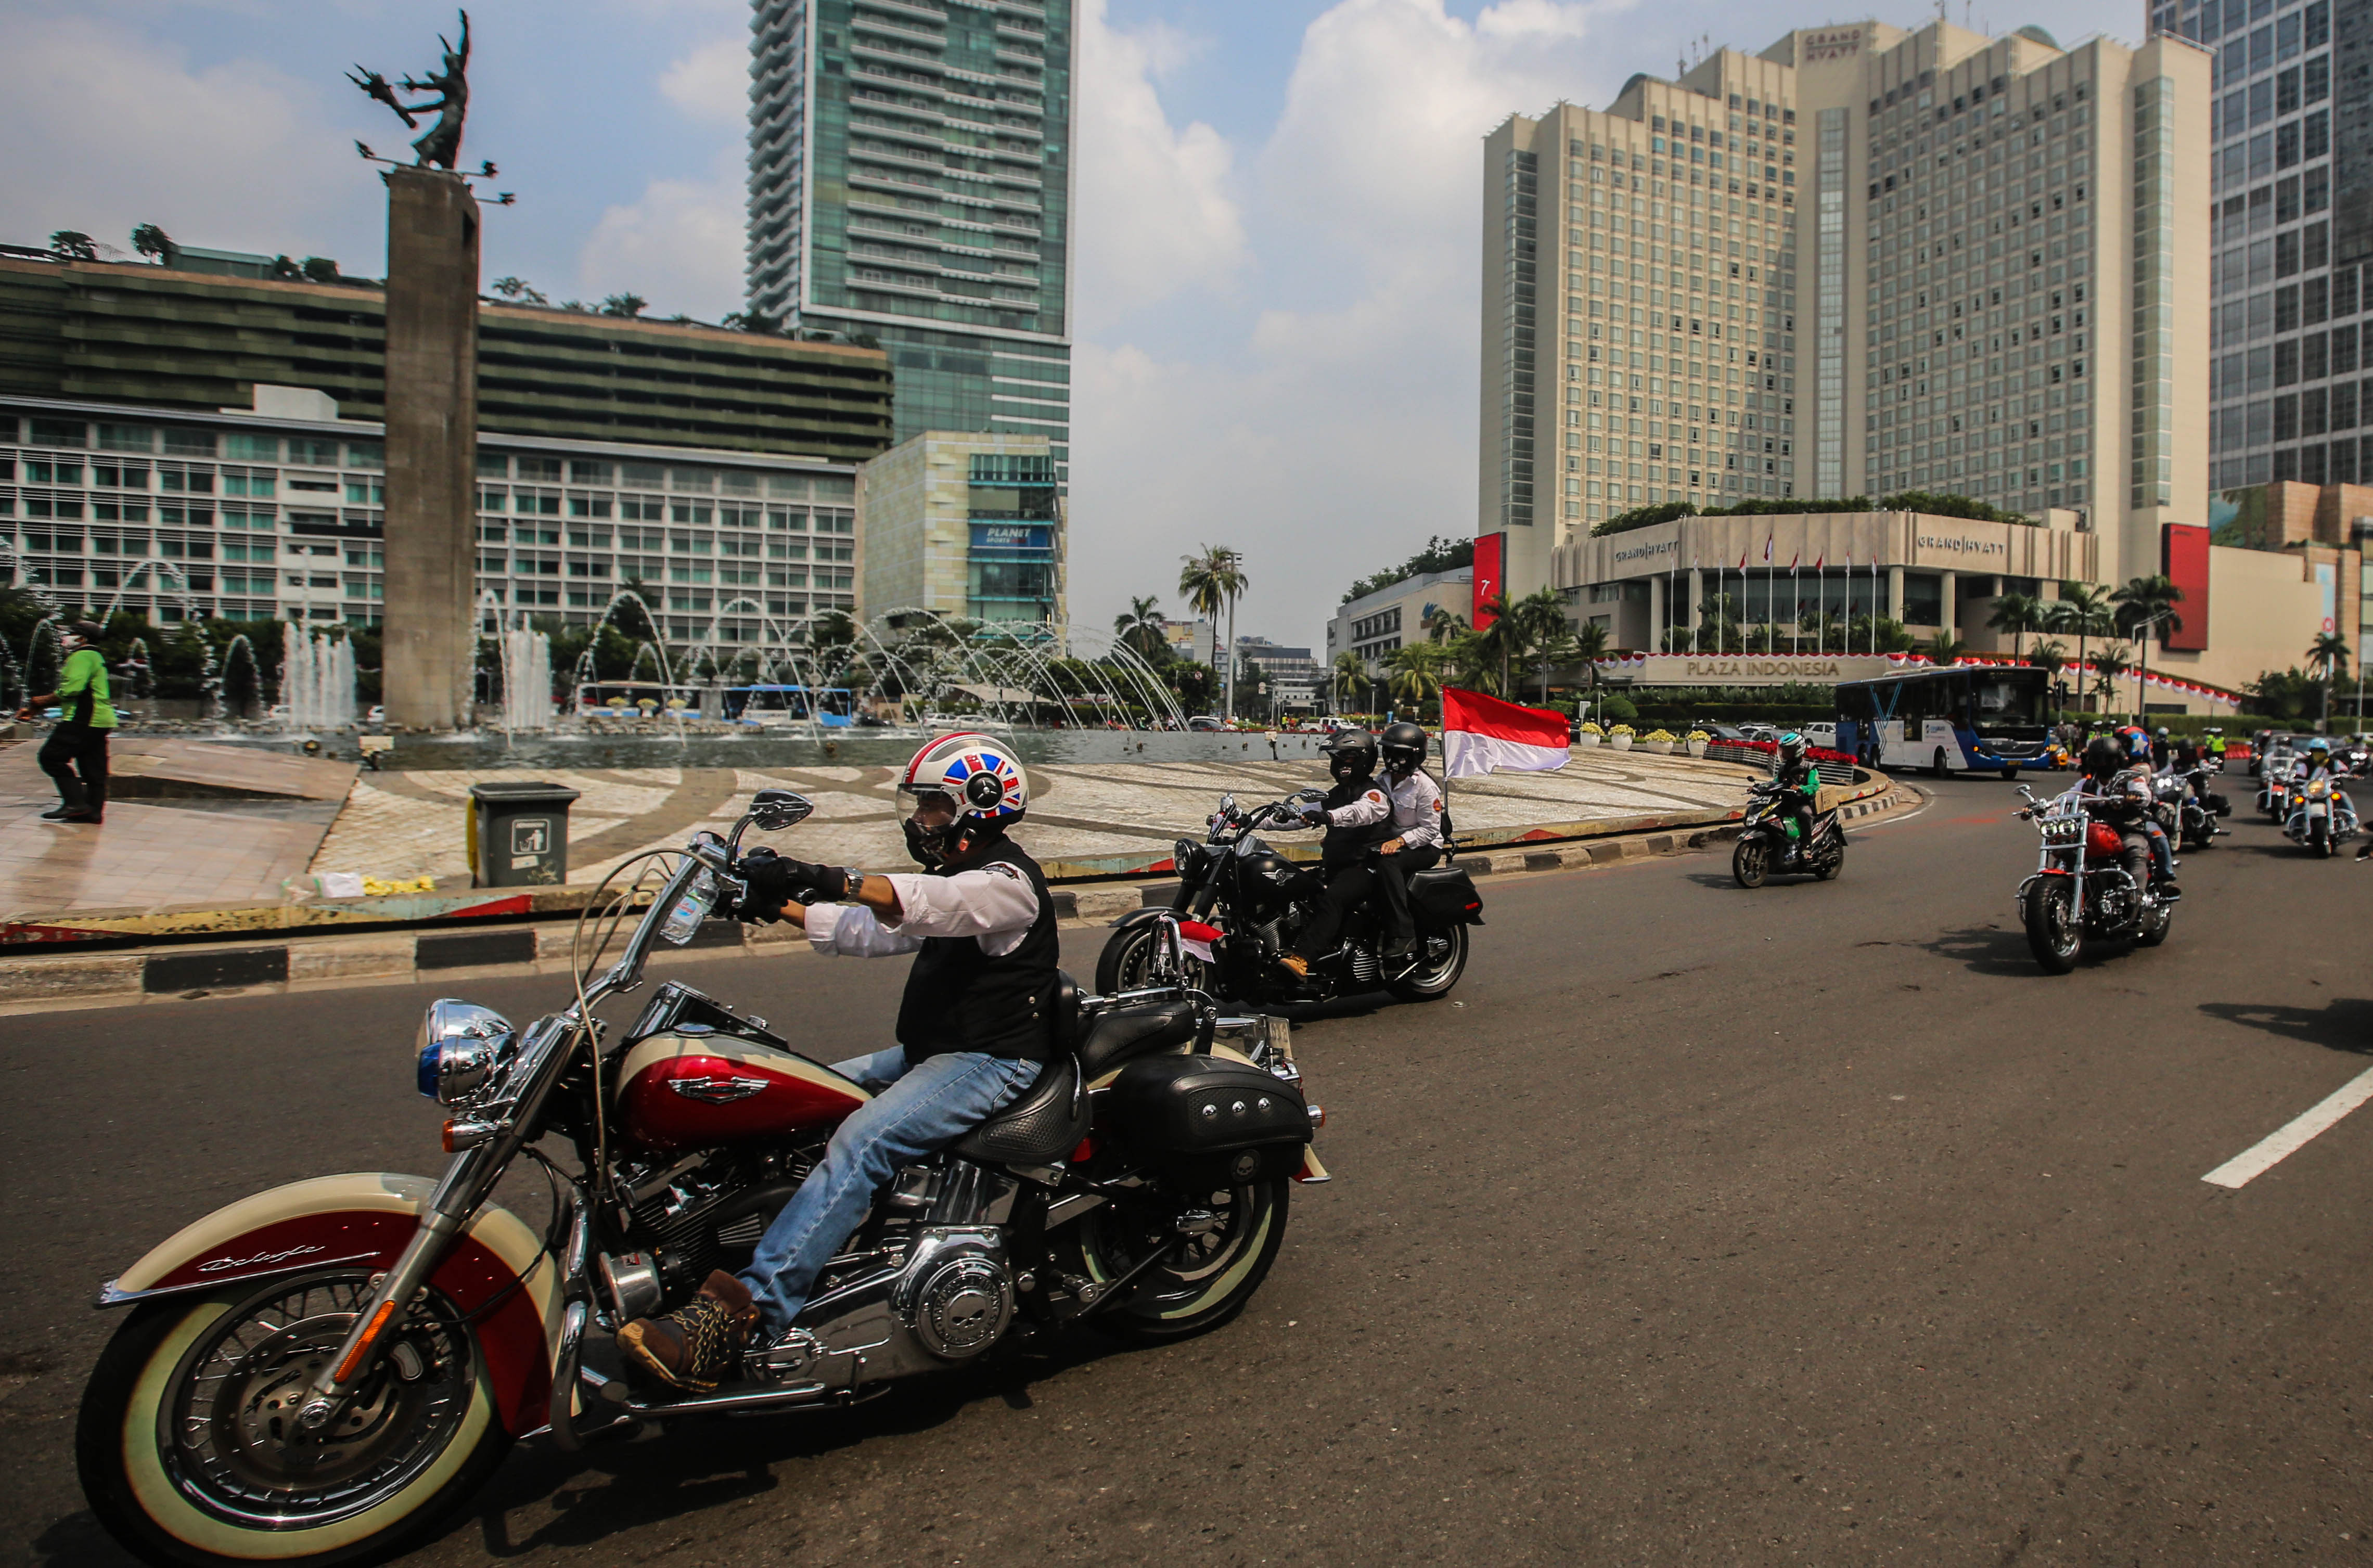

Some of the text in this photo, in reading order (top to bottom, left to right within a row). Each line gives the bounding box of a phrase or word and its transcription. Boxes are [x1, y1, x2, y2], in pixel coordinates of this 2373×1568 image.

[1805, 29, 1861, 45] GRAND
[1806, 45, 1859, 61] HYATT
[987, 528, 1031, 537] PLANET
[1615, 541, 1678, 562] GRAND HYATT
[1918, 535, 2006, 556] GRAND HYATT
[1481, 579, 1491, 596] 7
[1687, 662, 1840, 676] PLAZA INDONESIA
